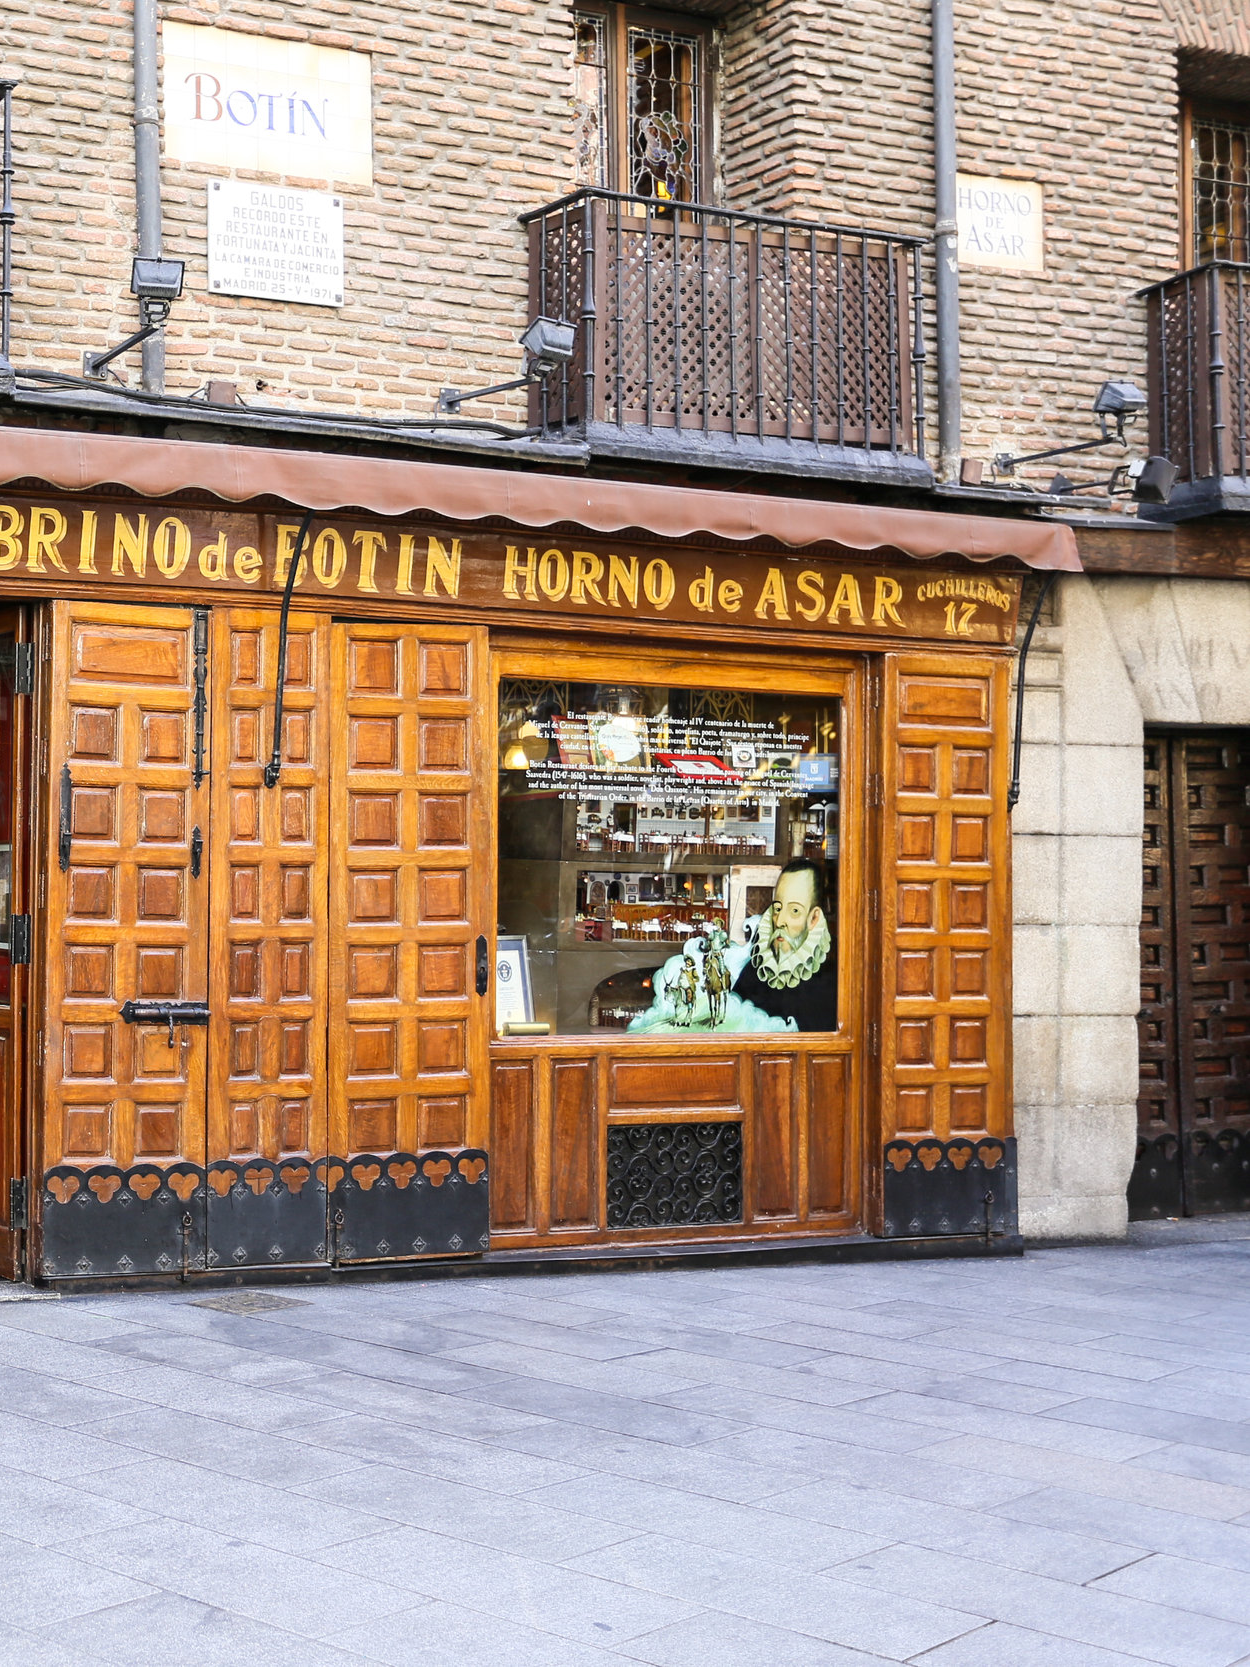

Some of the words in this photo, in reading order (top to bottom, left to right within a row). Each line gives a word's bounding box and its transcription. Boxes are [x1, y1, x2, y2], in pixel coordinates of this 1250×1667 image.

[250, 191, 304, 211] GALDOS
[958, 187, 1032, 216] HORNO
[290, 214, 321, 229] ESTE
[985, 216, 1004, 230] DE
[226, 221, 309, 242] RESTAURANTE
[313, 232, 328, 244] EN
[965, 224, 1027, 260] ASAR
[217, 234, 279, 253] FORTUNATA
[282, 242, 288, 253] Y
[290, 243, 336, 260] JACINTA
[215, 252, 227, 262] LA
[230, 254, 271, 268] CAMARA
[274, 259, 285, 269] DE
[288, 261, 339, 275] COMERCIO
[244, 268, 251, 277] E
[197, 531, 262, 583] de
[273, 524, 462, 599] BOTIN
[502, 545, 675, 611] HORNO
[688, 565, 743, 614] de
[754, 567, 906, 629] ASAR
[916, 578, 1012, 613] CUCHILLEROS
[551, 721, 559, 729] de
[559, 721, 589, 730] Cervantes
[567, 711, 575, 719] El
[704, 719, 733, 728] centenario
[734, 720, 741, 728] de
[741, 721, 747, 729] la
[768, 721, 775, 729] de
[525, 770, 551, 779] Saavedra
[588, 772, 602, 781] who
[550, 781, 570, 790] author
[570, 781, 578, 790] of
